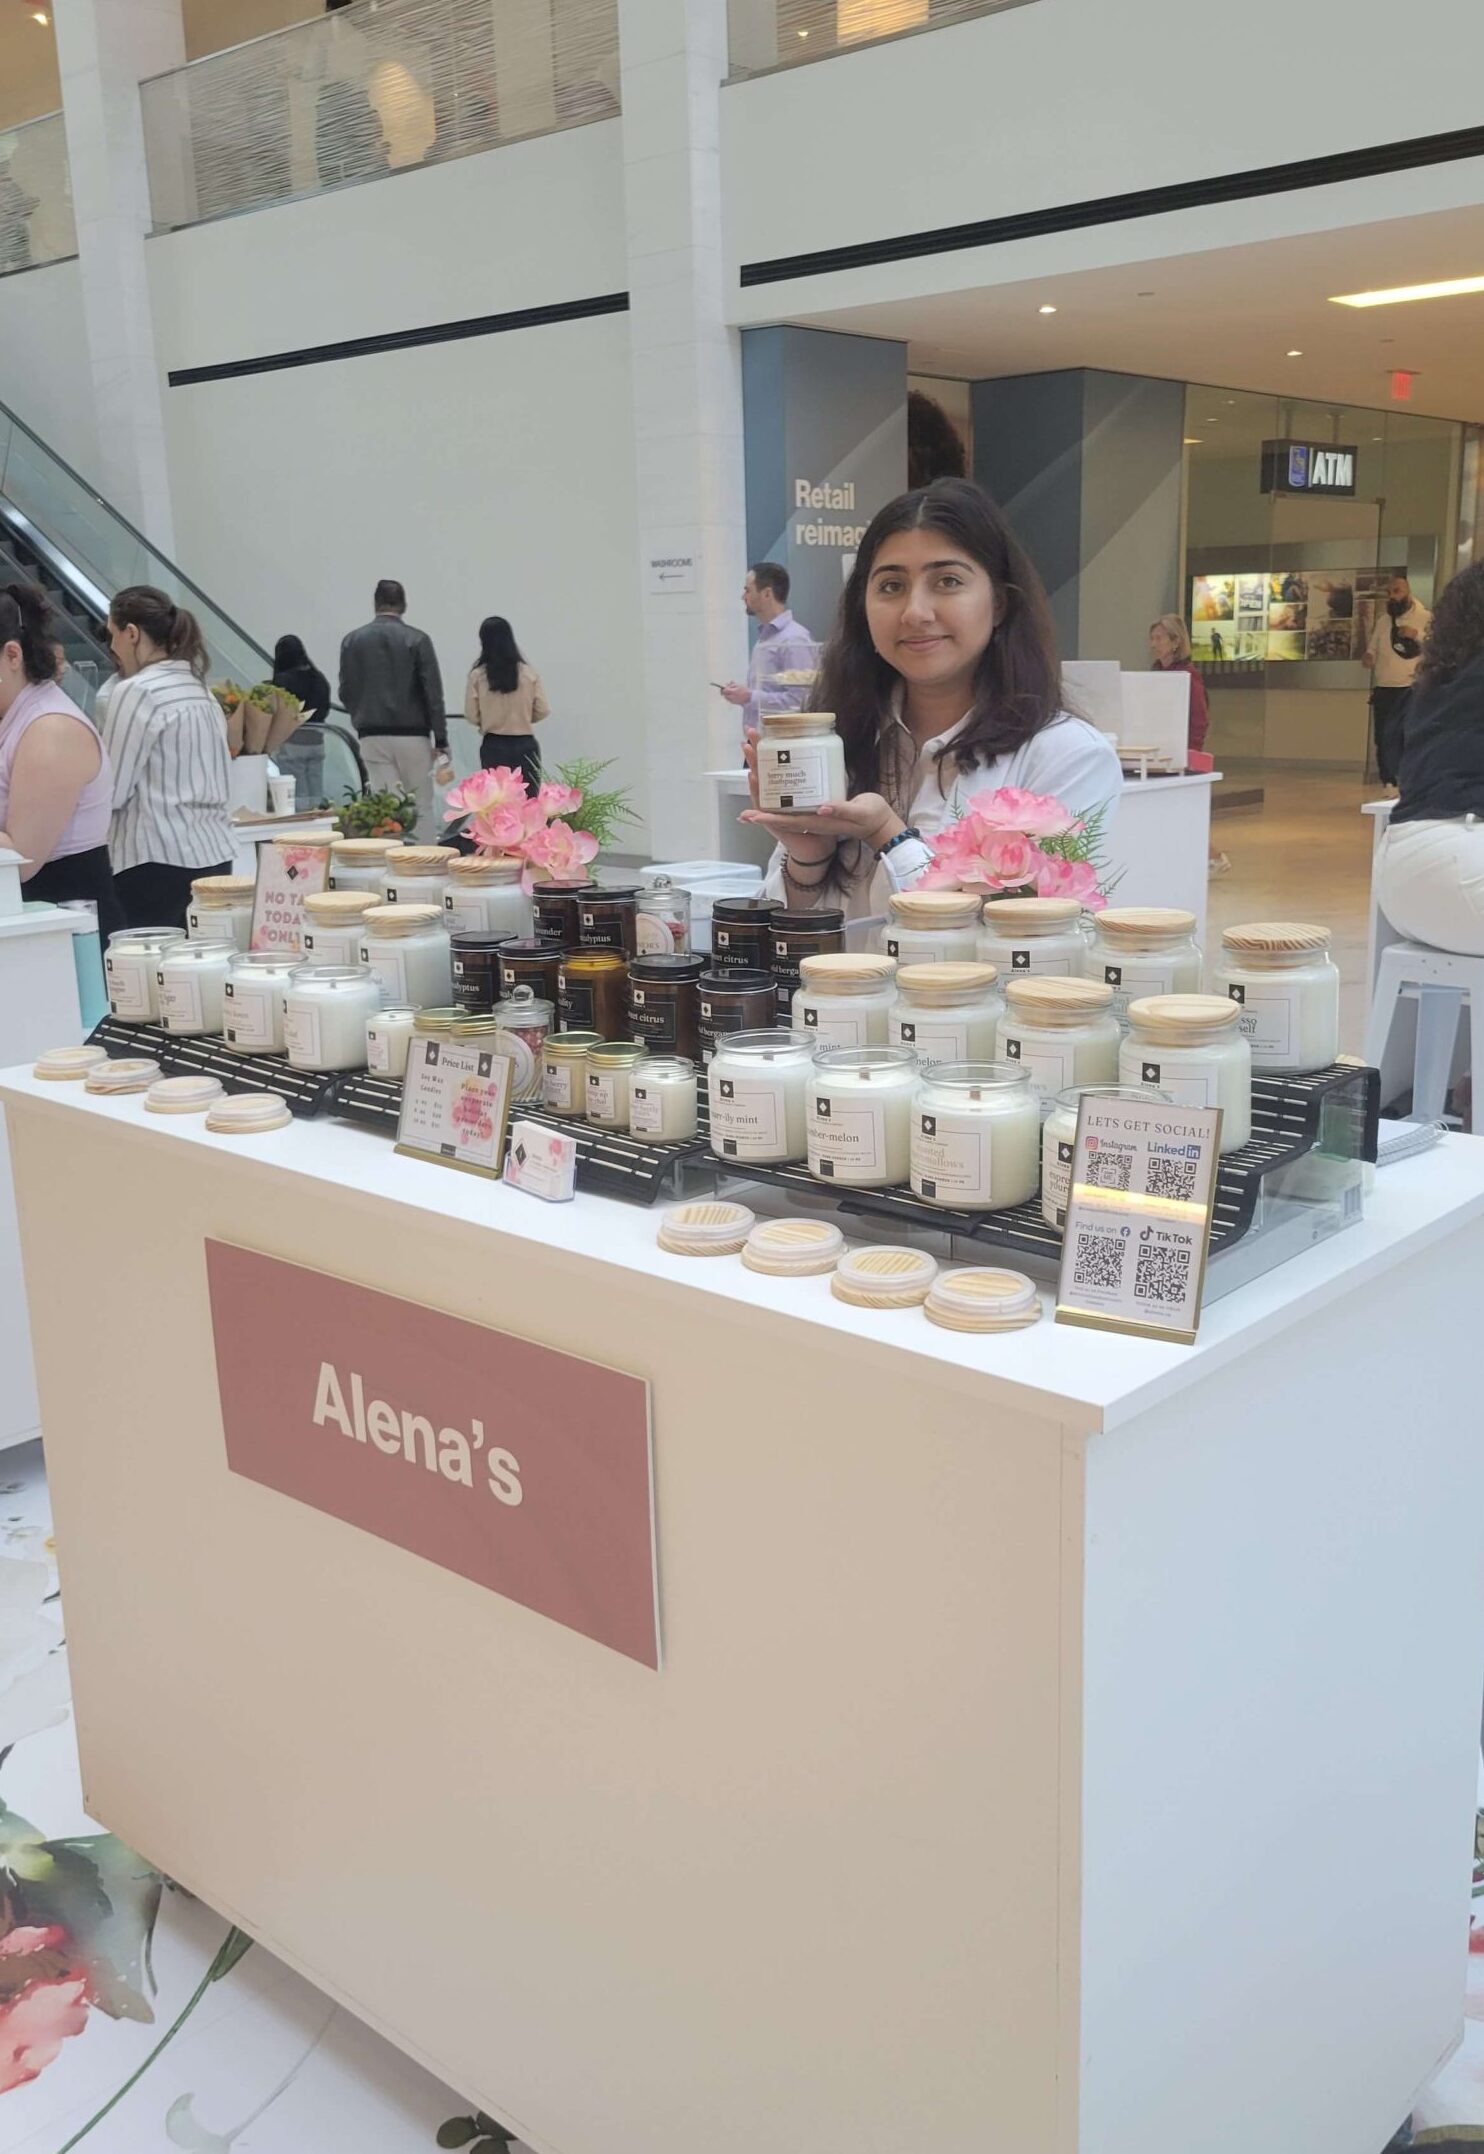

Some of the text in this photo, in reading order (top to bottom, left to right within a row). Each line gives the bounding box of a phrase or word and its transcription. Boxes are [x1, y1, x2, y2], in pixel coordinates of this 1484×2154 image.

[1312, 451, 1353, 487] ATM
[794, 478, 855, 511] Retail
[795, 517, 869, 551] reimag
[265, 891, 285, 905] NO
[723, 955, 749, 964] citrus
[638, 1014, 665, 1024] citrus
[441, 1056, 475, 1072] Price List
[736, 1114, 758, 1124] mint
[1087, 1115, 1210, 1139] LETS GET SOCIAL!
[1100, 1138, 1138, 1152] Instagram
[1075, 1221, 1117, 1234] Find us on
[1155, 1231, 1193, 1246] TikTok
[312, 1361, 524, 1507] Alena's
